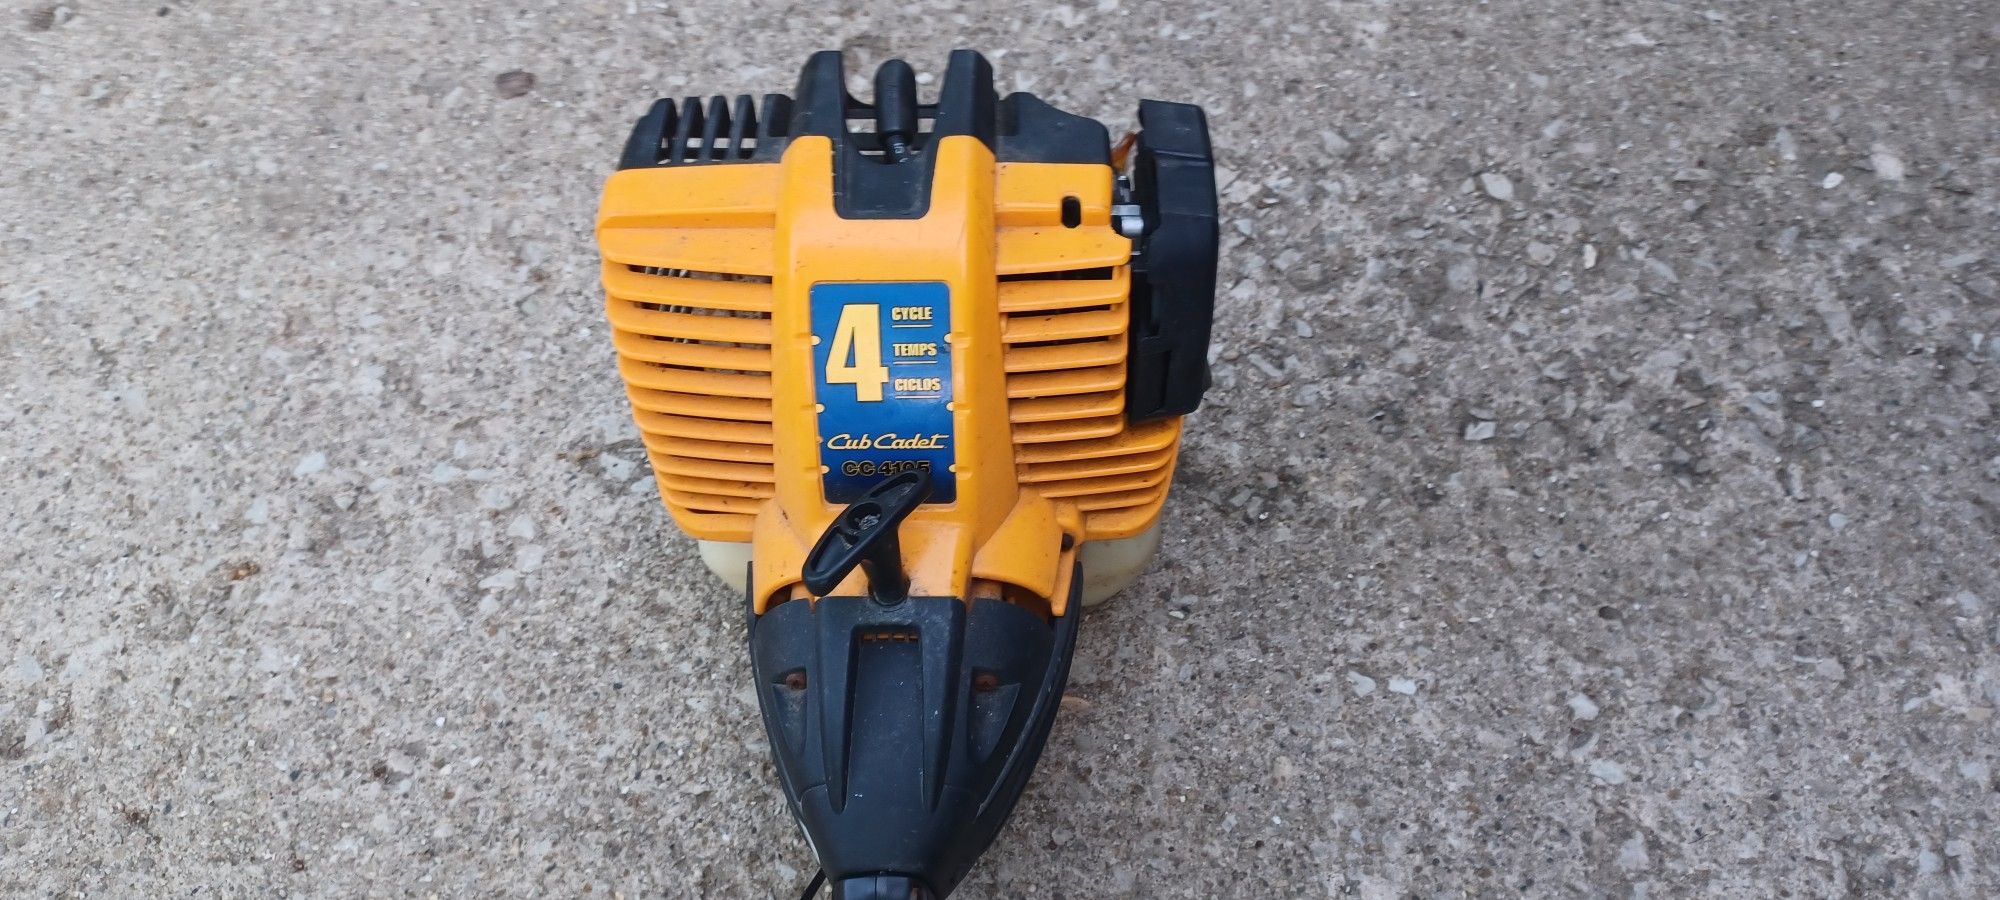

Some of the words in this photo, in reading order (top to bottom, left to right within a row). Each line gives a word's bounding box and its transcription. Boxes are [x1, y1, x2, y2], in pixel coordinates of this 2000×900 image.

[892, 307, 933, 320] CYCLE
[826, 304, 889, 402] 4
[893, 343, 937, 356] TEMPS
[894, 378, 941, 391] CICLOS
[827, 433, 872, 450] Cub
[873, 433, 949, 449] Cadet
[841, 460, 875, 477] CC
